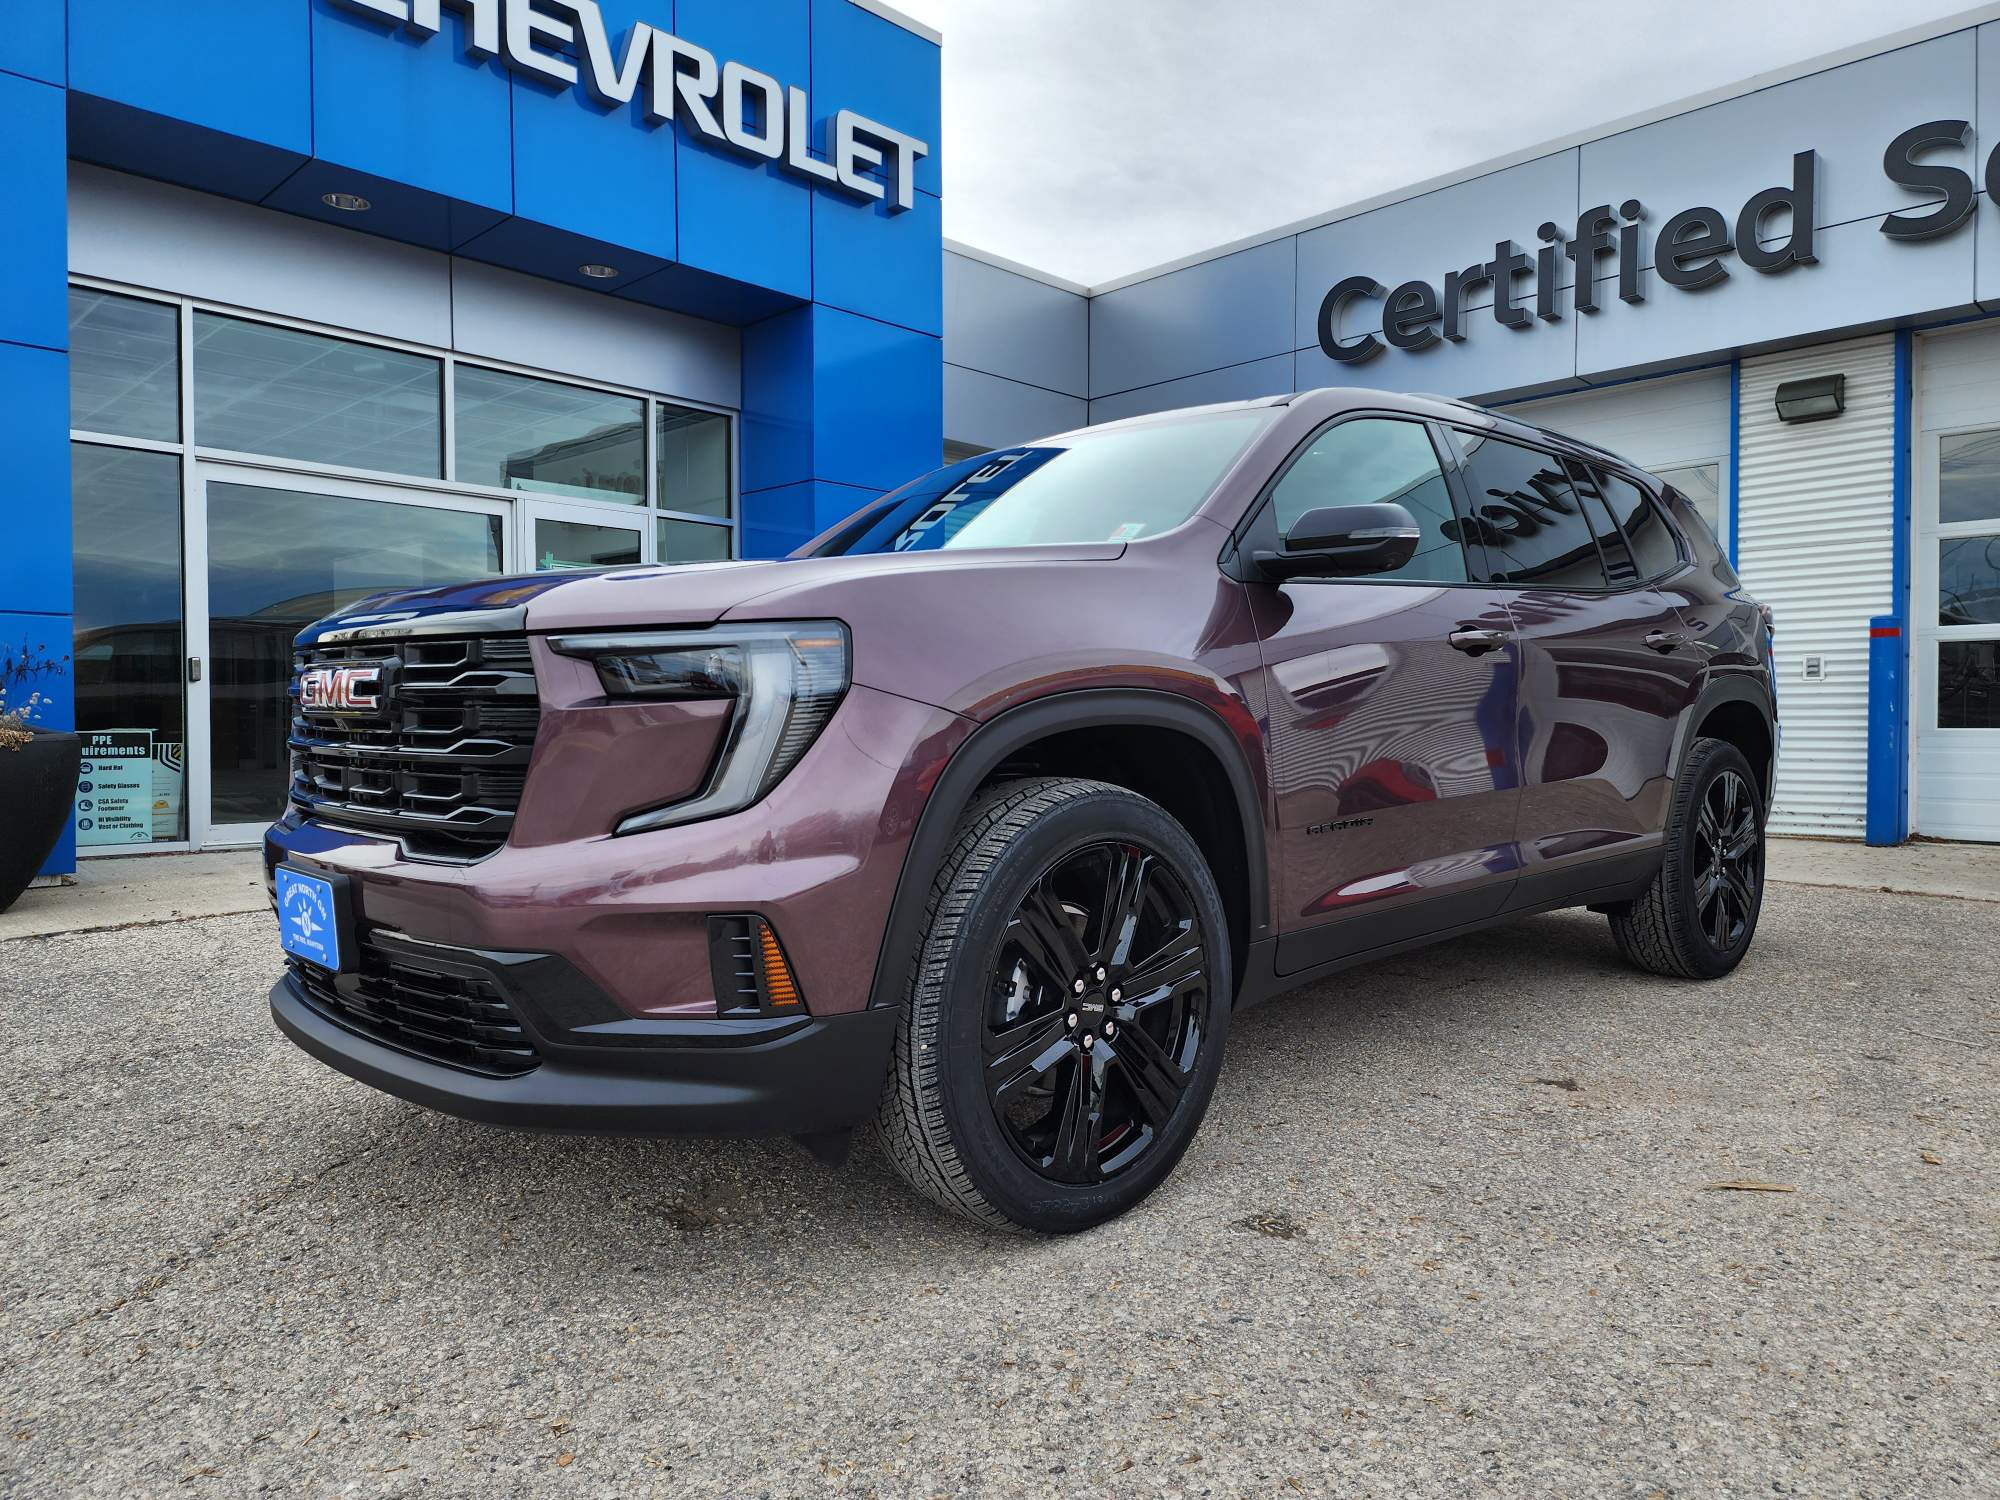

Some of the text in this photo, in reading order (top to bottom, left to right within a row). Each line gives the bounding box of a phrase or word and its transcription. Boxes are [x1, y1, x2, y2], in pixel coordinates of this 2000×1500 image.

[328, 0, 929, 212] EVROLET
[1317, 119, 2000, 364] Certified S
[300, 667, 380, 709] GMC
[92, 735, 112, 745] PPE
[81, 745, 146, 756] uirements
[105, 815, 132, 823] Visibility
[119, 822, 144, 830] Clothing
[298, 883, 317, 903] NORTH
